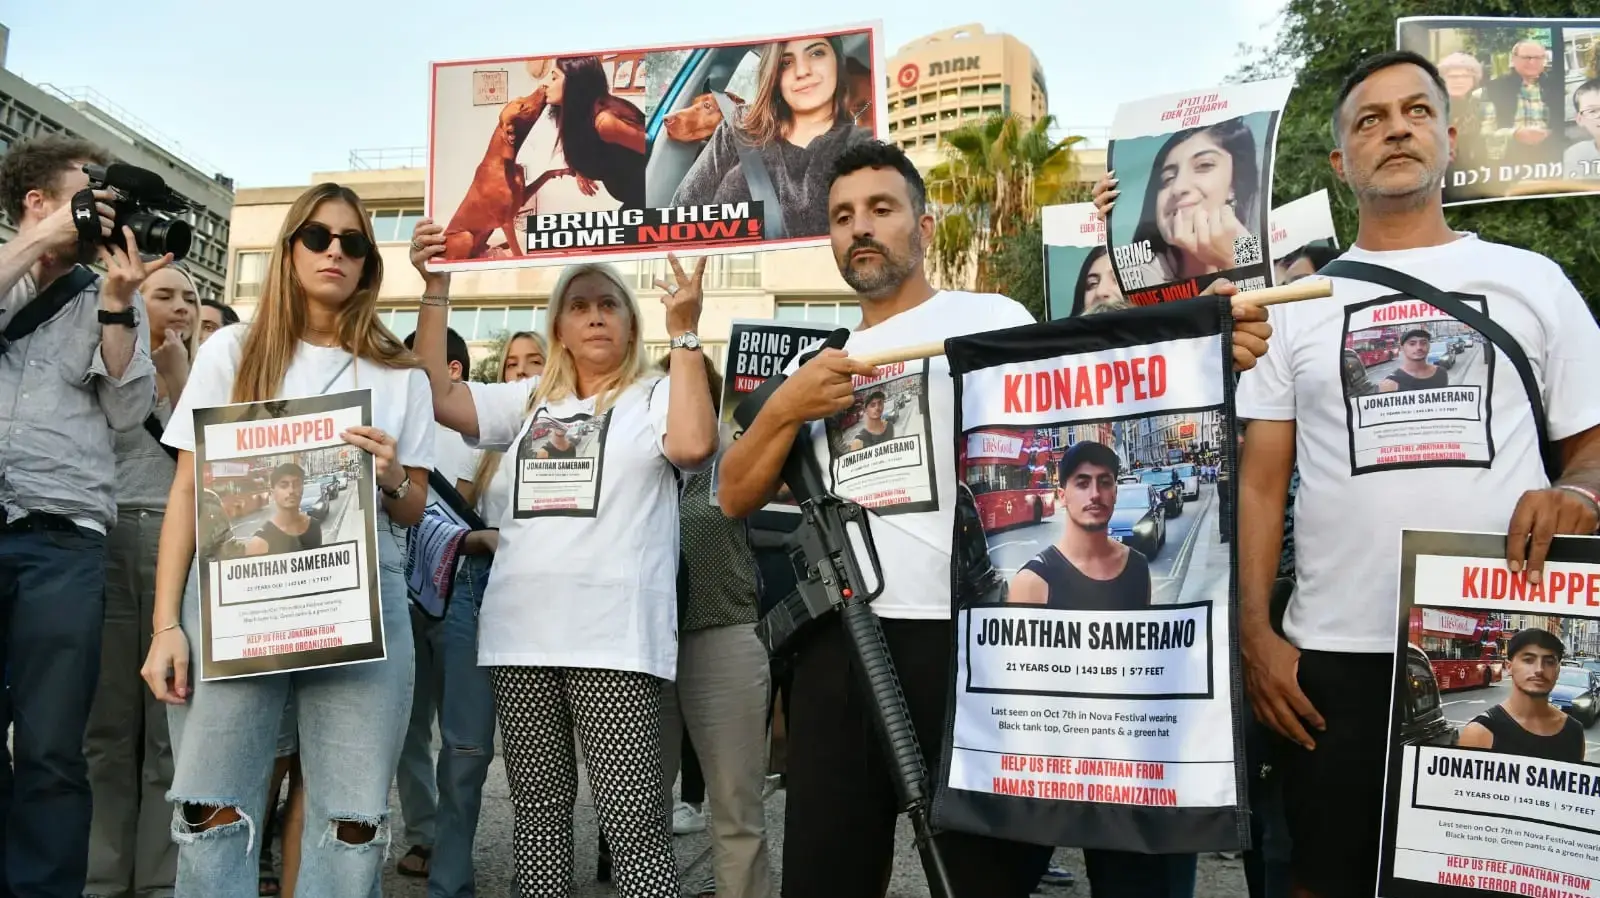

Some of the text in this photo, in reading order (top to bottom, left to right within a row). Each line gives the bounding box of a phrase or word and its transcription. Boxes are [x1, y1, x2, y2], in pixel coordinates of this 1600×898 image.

[928, 55, 981, 77] אמות
[1161, 100, 1228, 121] EDEN ZECHARYA
[1453, 165, 1491, 187] לכם
[1499, 161, 1563, 182] מחכים
[536, 201, 749, 232] BRING THEM
[527, 226, 625, 250] HOME
[1113, 239, 1152, 270] BRING
[1120, 268, 1145, 292] HER
[1372, 303, 1448, 323] KIDNAPP
[739, 331, 791, 356] BRING
[736, 352, 784, 377] BACK
[1004, 354, 1167, 413] KIDNAPPED
[1363, 391, 1474, 410] JONATHAN SAMERANO
[236, 417, 334, 451] KIDNAPPED
[526, 461, 590, 470] JONATHAN SAMERANO
[841, 450, 873, 469] JONATHAN
[874, 440, 915, 457] SAMERANO
[227, 550, 350, 581] JONATHAN SAMERANO
[1462, 566, 1600, 607] KIDNAPPE
[242, 636, 343, 657] HAMAS TERROR ORGANIZATION
[246, 633, 262, 644] HELP
[272, 631, 286, 641] FREE
[287, 627, 318, 639] JONATHAN
[318, 624, 336, 635] FROM
[977, 618, 1196, 650] JONATHAN SAMERANO
[1006, 663, 1165, 676] 21 YEARS OLD 143 LBS 5'7 FEET
[991, 706, 1007, 716] Last
[1008, 709, 1028, 717] seen
[1043, 709, 1059, 718] Oct
[1062, 710, 1077, 719] 7th
[1078, 710, 1087, 720] in
[1089, 712, 1112, 721] Nova
[1114, 712, 1147, 722] Festival
[1148, 713, 1178, 724] wearing
[998, 721, 1020, 730] Black
[1023, 723, 1042, 732] tank
[1044, 724, 1061, 734] top,
[1062, 724, 1089, 734] Green
[1091, 727, 1116, 736] pants
[1117, 727, 1125, 736] &
[1134, 729, 1156, 738] green
[1157, 728, 1170, 737] hat
[1001, 755, 1164, 780] HELP US FREE JONATHAN FROM
[1427, 755, 1600, 798] JONATHAN SAMERA
[992, 777, 1177, 806] HAMAS TERROR ORGANIZATION
[1454, 789, 1595, 816] 21 YEARS OLD 143 LBS 5'7 FEET
[1438, 820, 1454, 828] Last
[1484, 825, 1498, 833] Oct
[1500, 827, 1513, 835] 7th
[1523, 830, 1544, 840] Nova
[1545, 834, 1575, 847] Festival
[1576, 842, 1600, 851] weari
[1445, 831, 1465, 839] Black
[1467, 834, 1483, 842] tank
[1500, 837, 1523, 846] Green
[1525, 841, 1546, 851] pants
[1547, 845, 1554, 853] &
[1562, 849, 1584, 859] green
[1585, 852, 1599, 862] hat
[1437, 871, 1475, 888] HAMAS
[1477, 876, 1517, 893] TERROR
[1447, 855, 1591, 891] HELP US FREE JONATHAN FROM
